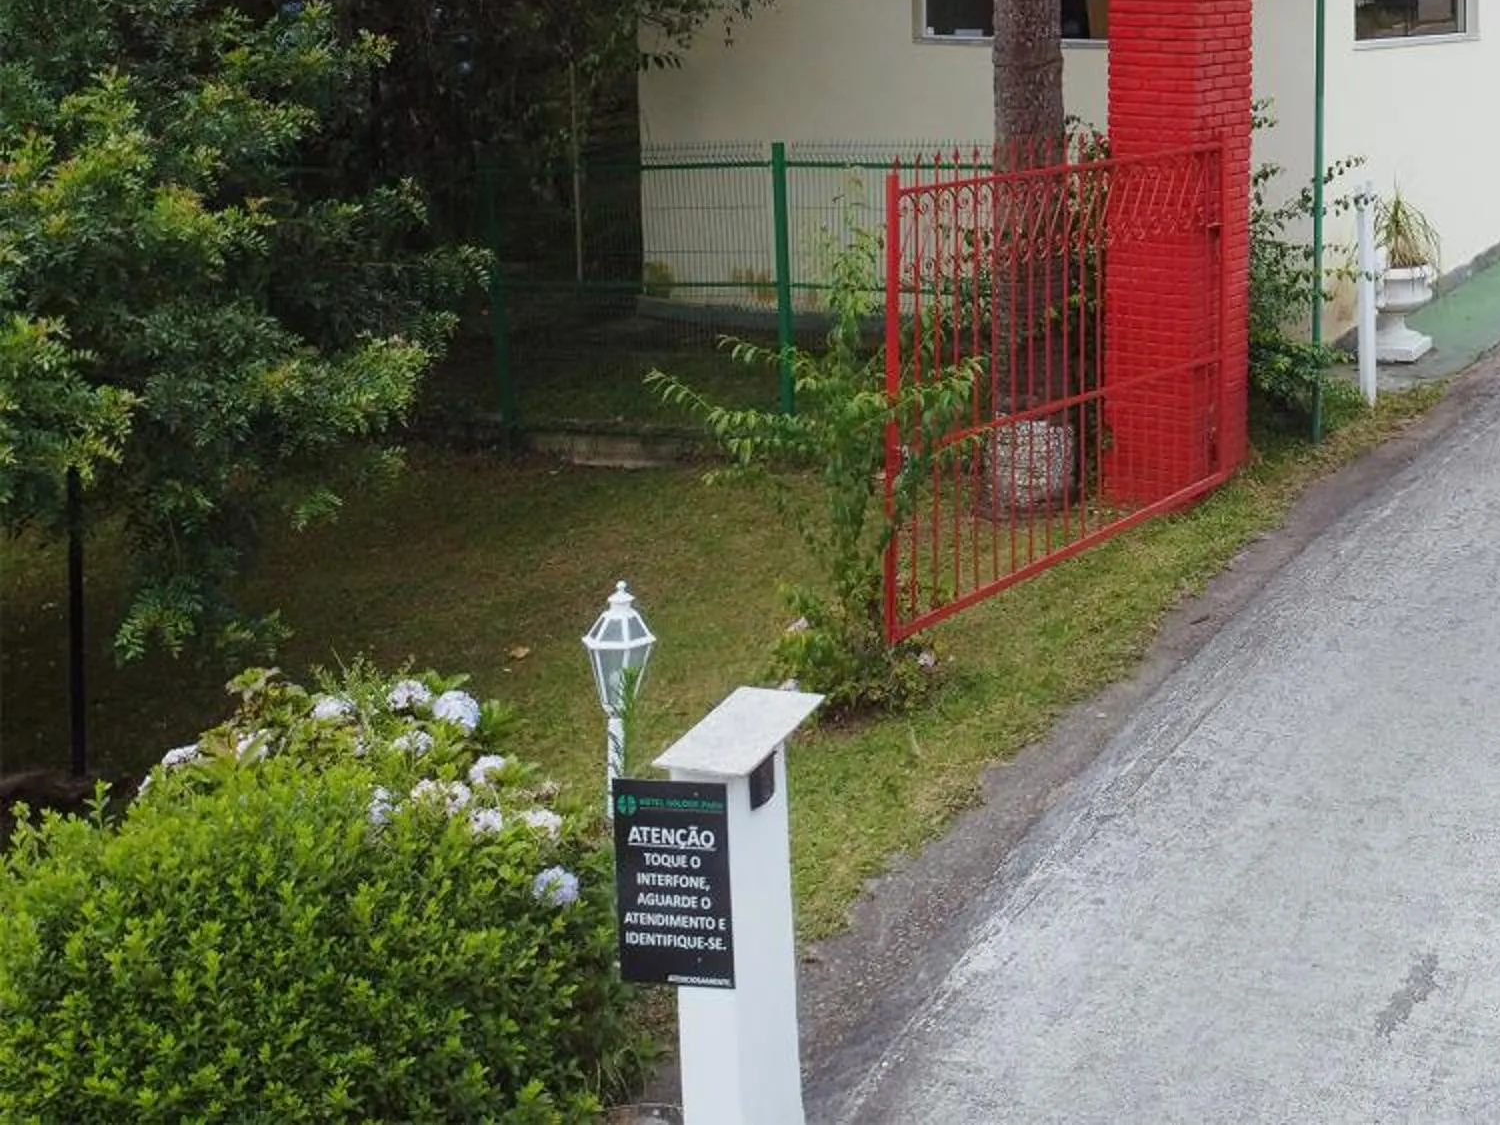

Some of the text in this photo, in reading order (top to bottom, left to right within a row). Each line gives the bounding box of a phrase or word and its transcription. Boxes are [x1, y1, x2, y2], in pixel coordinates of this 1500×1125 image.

[628, 825, 715, 850] ATENÇÃO
[644, 852, 701, 868] TOQUE O
[637, 872, 711, 891] INTERFONE,
[637, 893, 712, 909] AGUARDE O
[624, 912, 726, 930] ATENDIMENTO E
[625, 931, 727, 950] IDENTIFIQUE-SE.
